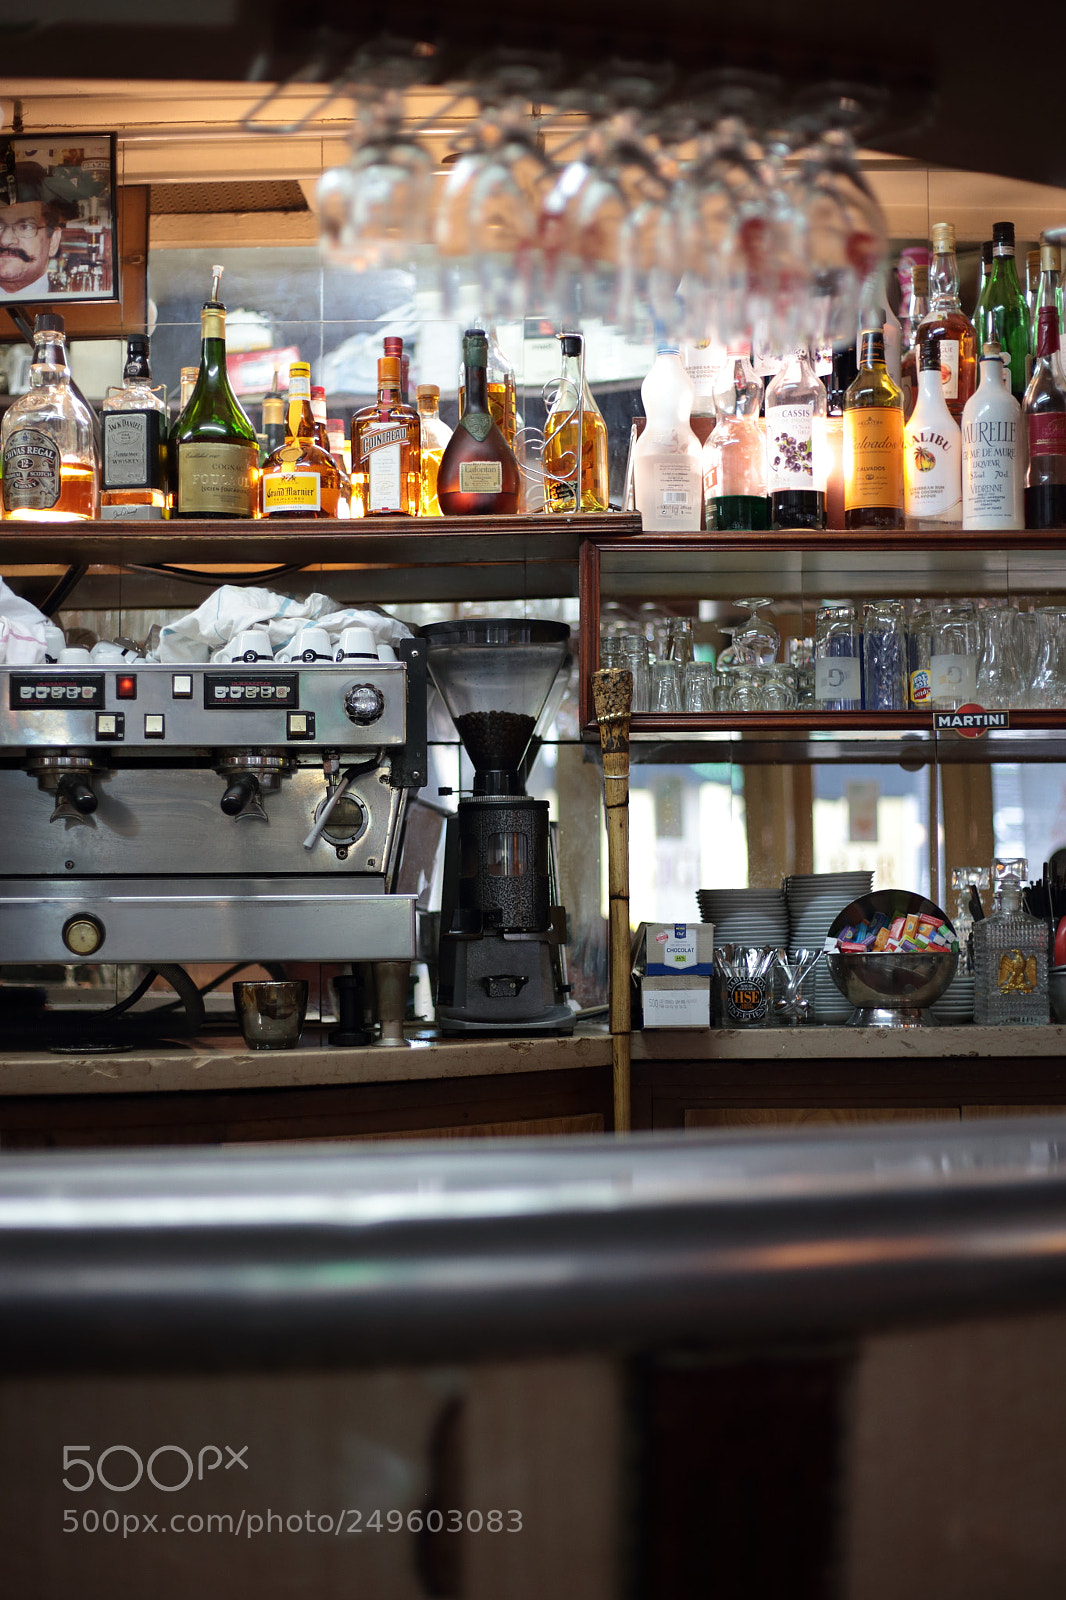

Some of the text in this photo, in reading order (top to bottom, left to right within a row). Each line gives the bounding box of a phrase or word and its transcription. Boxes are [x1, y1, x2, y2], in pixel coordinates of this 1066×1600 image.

[108, 422, 121, 432] JACK
[362, 428, 407, 453] COINTREAU
[963, 421, 1017, 447] MURELLE
[4, 446, 54, 462] CHIVAS REGAL
[982, 448, 994, 457] DE
[21, 459, 29, 468] 12
[267, 487, 315, 498] Grand Marnier
[938, 714, 1004, 727] MARTINI
[734, 991, 760, 1004] HSE
